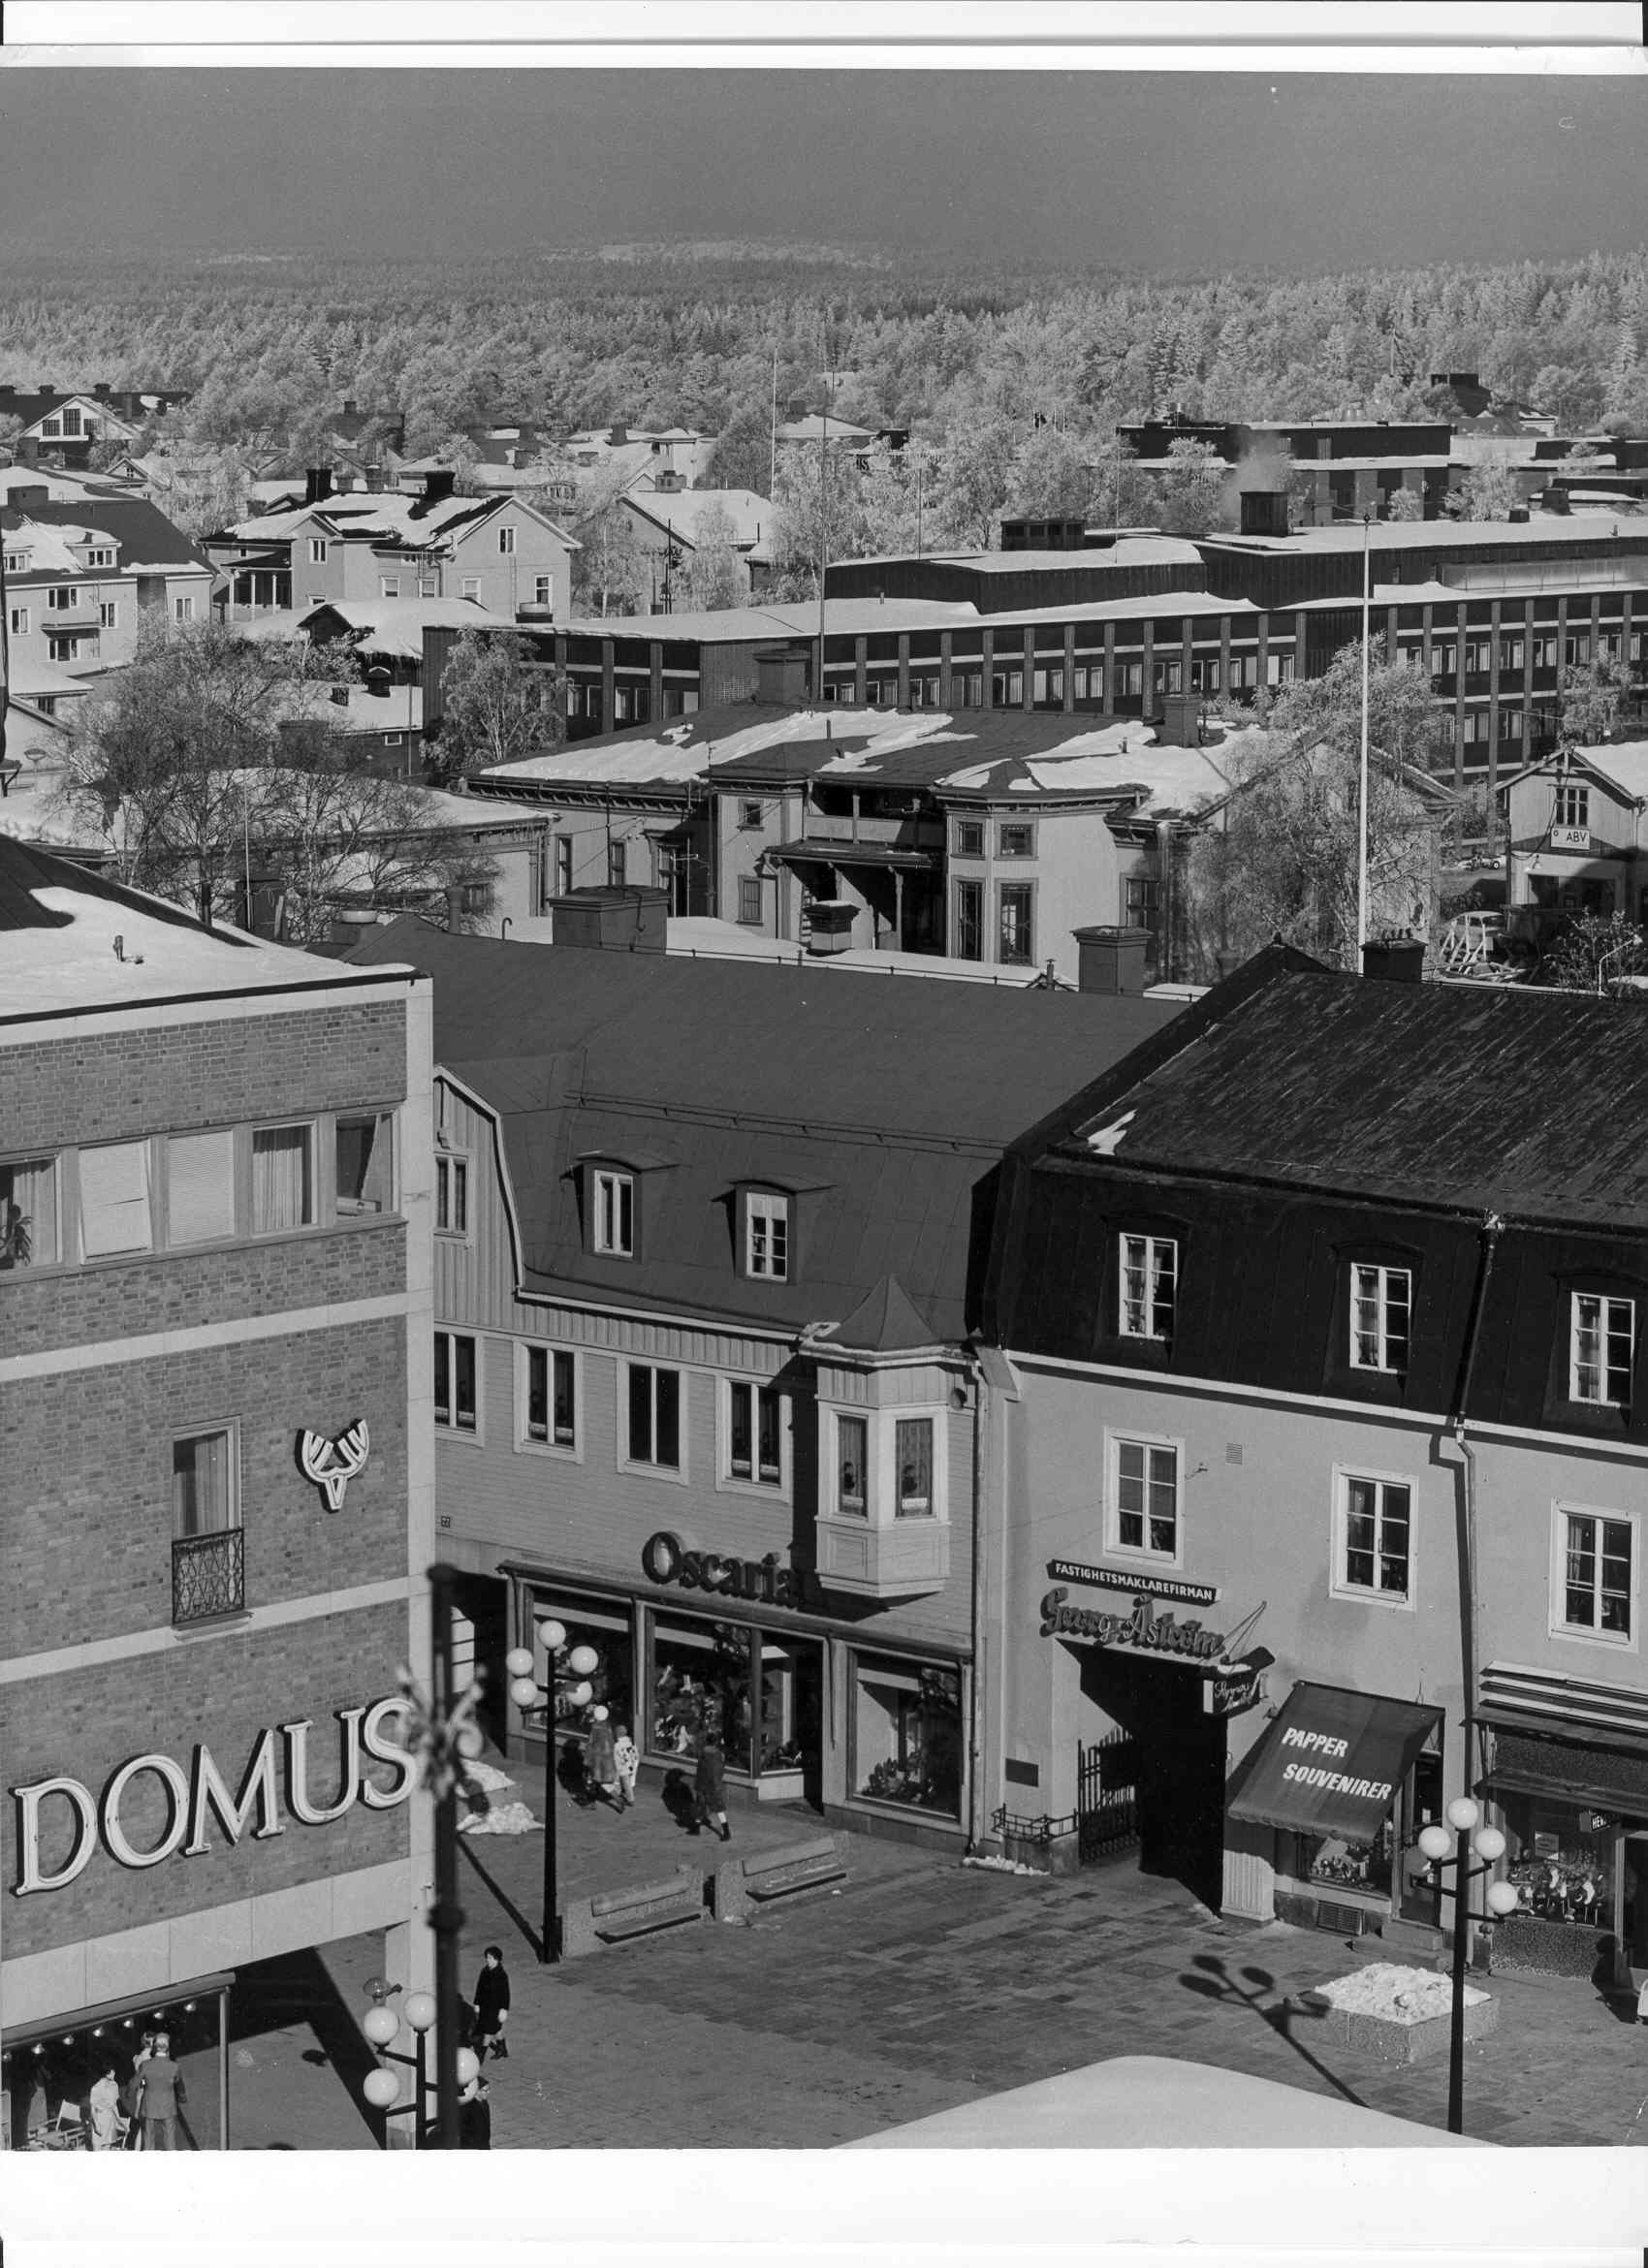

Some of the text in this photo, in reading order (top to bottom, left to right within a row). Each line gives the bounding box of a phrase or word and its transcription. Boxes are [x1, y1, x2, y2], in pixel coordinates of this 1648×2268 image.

[1566, 831, 1587, 842] ABV
[642, 1531, 799, 1610] Oscaria
[1282, 1727, 1348, 1757] PAPPER
[9, 1696, 418, 1898] DOMUS
[1283, 1763, 1392, 1800] SOUVENIRER
